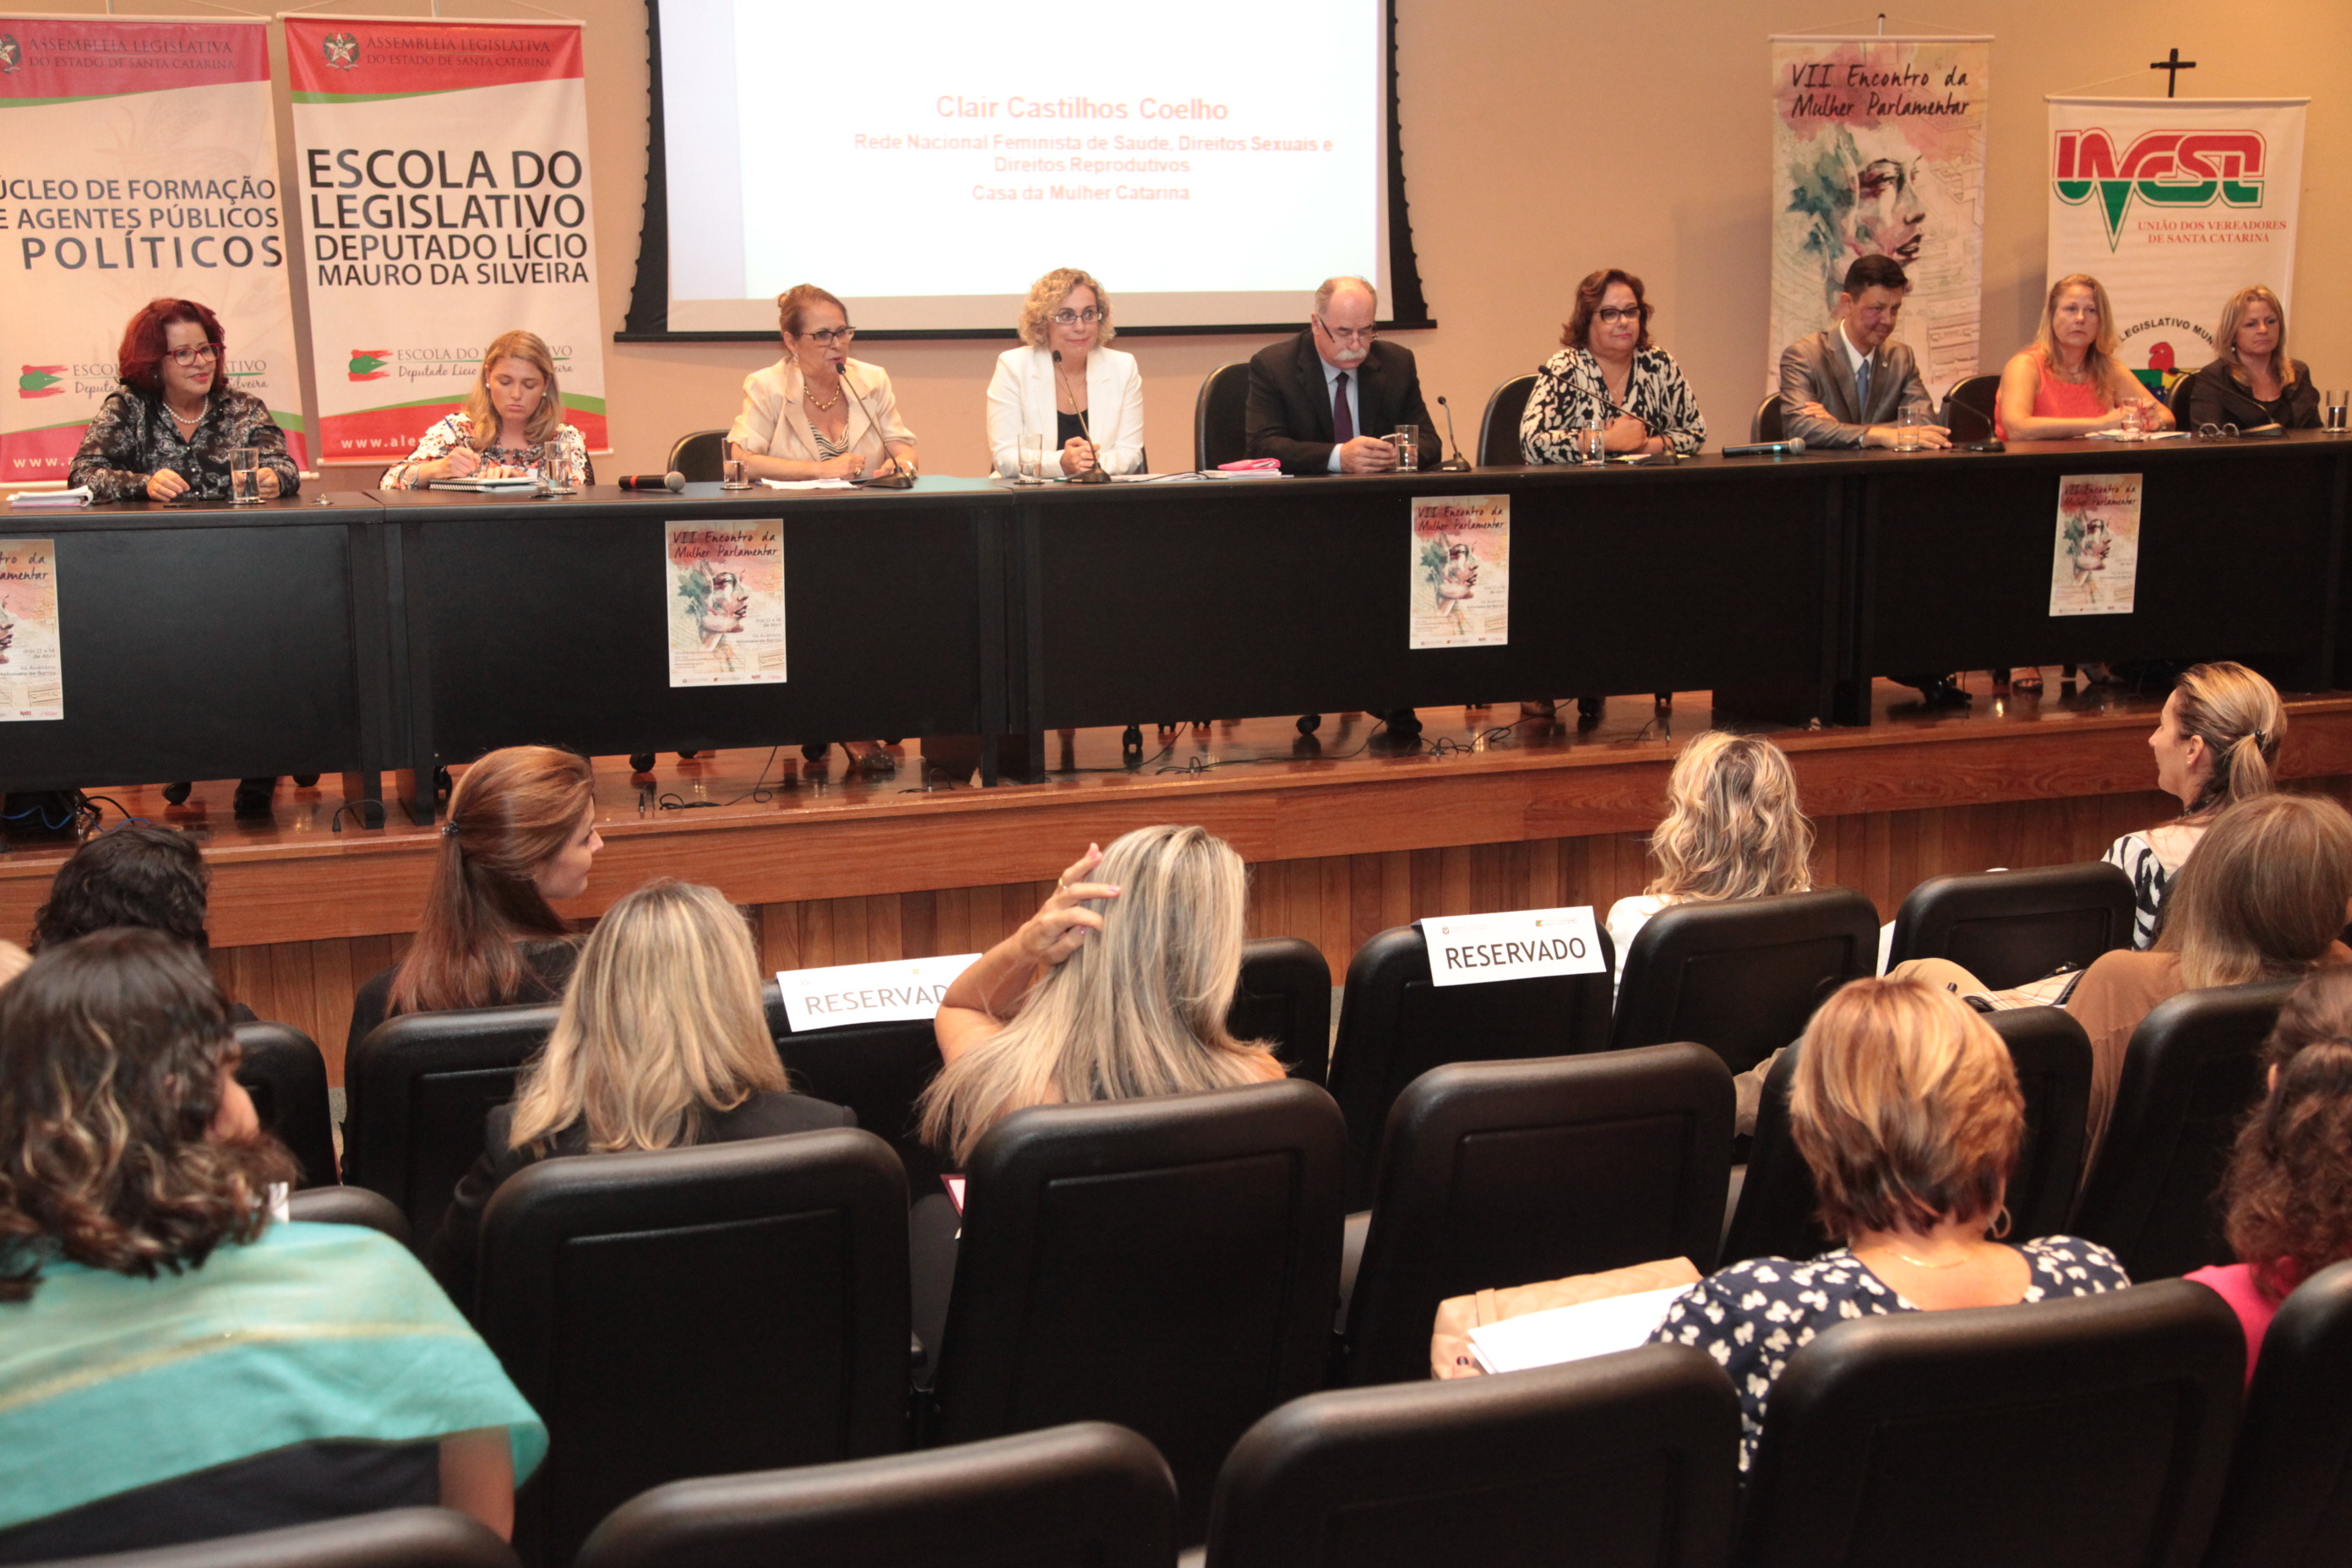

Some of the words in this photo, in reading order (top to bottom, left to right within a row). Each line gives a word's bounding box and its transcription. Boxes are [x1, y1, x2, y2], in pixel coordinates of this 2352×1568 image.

[30, 38, 130, 52] ASSEMBLEIA
[132, 41, 233, 54] LEGISLATIVA
[366, 36, 458, 51] ASSEMBLEIA
[460, 38, 551, 52] LEGISLATIVA
[30, 56, 52, 68] DO
[54, 57, 105, 68] ESTADO
[108, 57, 126, 68] DE
[128, 57, 171, 69] SANTA
[172, 58, 236, 70] CATARINA
[367, 54, 387, 65] DO
[389, 54, 435, 66] ESTADO
[438, 55, 455, 66] DE
[456, 56, 493, 67] SANTA
[495, 56, 552, 68] CATARINA
[1793, 63, 1833, 88] VII
[1848, 63, 1929, 87] Encontro
[1944, 65, 1968, 86] da
[936, 95, 999, 119] Clair
[1006, 95, 1129, 120] Castilhos
[1139, 97, 1228, 121] Coelho
[1792, 94, 1854, 117] Mulher
[1867, 91, 1969, 117] Parlamentar
[853, 133, 904, 152] Rede
[906, 133, 989, 152] Nacional
[993, 133, 1082, 152] Feminista
[1086, 135, 1110, 153] de
[1178, 134, 1247, 154] Direitos
[1250, 135, 1320, 154] Sexuais
[1322, 141, 1334, 154] e
[308, 149, 498, 188] ESCOLA
[512, 150, 582, 188] DO
[994, 155, 1066, 175] Direitos
[1070, 156, 1192, 177] Reprodutivos
[85, 179, 122, 200] DE
[128, 175, 276, 205] FORMAÇÃO
[972, 184, 1019, 202] Casa
[1021, 184, 1046, 202] da
[1049, 184, 1113, 202] Mulher
[1115, 184, 1191, 202] Catarina
[17, 207, 142, 230] AGENTES
[149, 203, 280, 230] PÚBLICOS
[310, 193, 585, 230] LEGISLATIVO
[2137, 219, 2177, 231] UNIÃO
[2180, 221, 2205, 231] DOS
[2208, 220, 2287, 231] VEREADORES
[314, 233, 498, 262] DEPUTADO
[506, 228, 588, 260] LÍCIO
[2148, 233, 2164, 244] DE
[2166, 233, 2206, 244] SANTA
[2208, 232, 2270, 244] CATARINA
[21, 229, 283, 270] POLÍTICOS
[318, 263, 422, 286] MAURO
[430, 263, 469, 286] DA
[476, 262, 590, 285] SILVEIRA
[2119, 317, 2190, 342] LEGISLATIVO
[398, 348, 451, 361] ESCOLA
[456, 347, 479, 360] DO
[233, 376, 269, 389] ilveira
[400, 364, 448, 383] Deputado
[452, 363, 476, 376] Lício
[1418, 507, 1436, 518] VII
[1444, 506, 1484, 517] Encontro
[1491, 505, 1503, 515] da
[1419, 520, 1447, 531] Mulher
[1455, 518, 1505, 530] Parlamentar
[673, 531, 697, 545] VII
[705, 531, 753, 543] Encontro
[762, 531, 776, 542] da
[29, 552, 46, 564] da
[675, 546, 710, 558] Mulher
[718, 544, 777, 557] Parlamentar
[1446, 938, 1586, 969] RESERVADO
[805, 984, 948, 1015] RESERVAD
